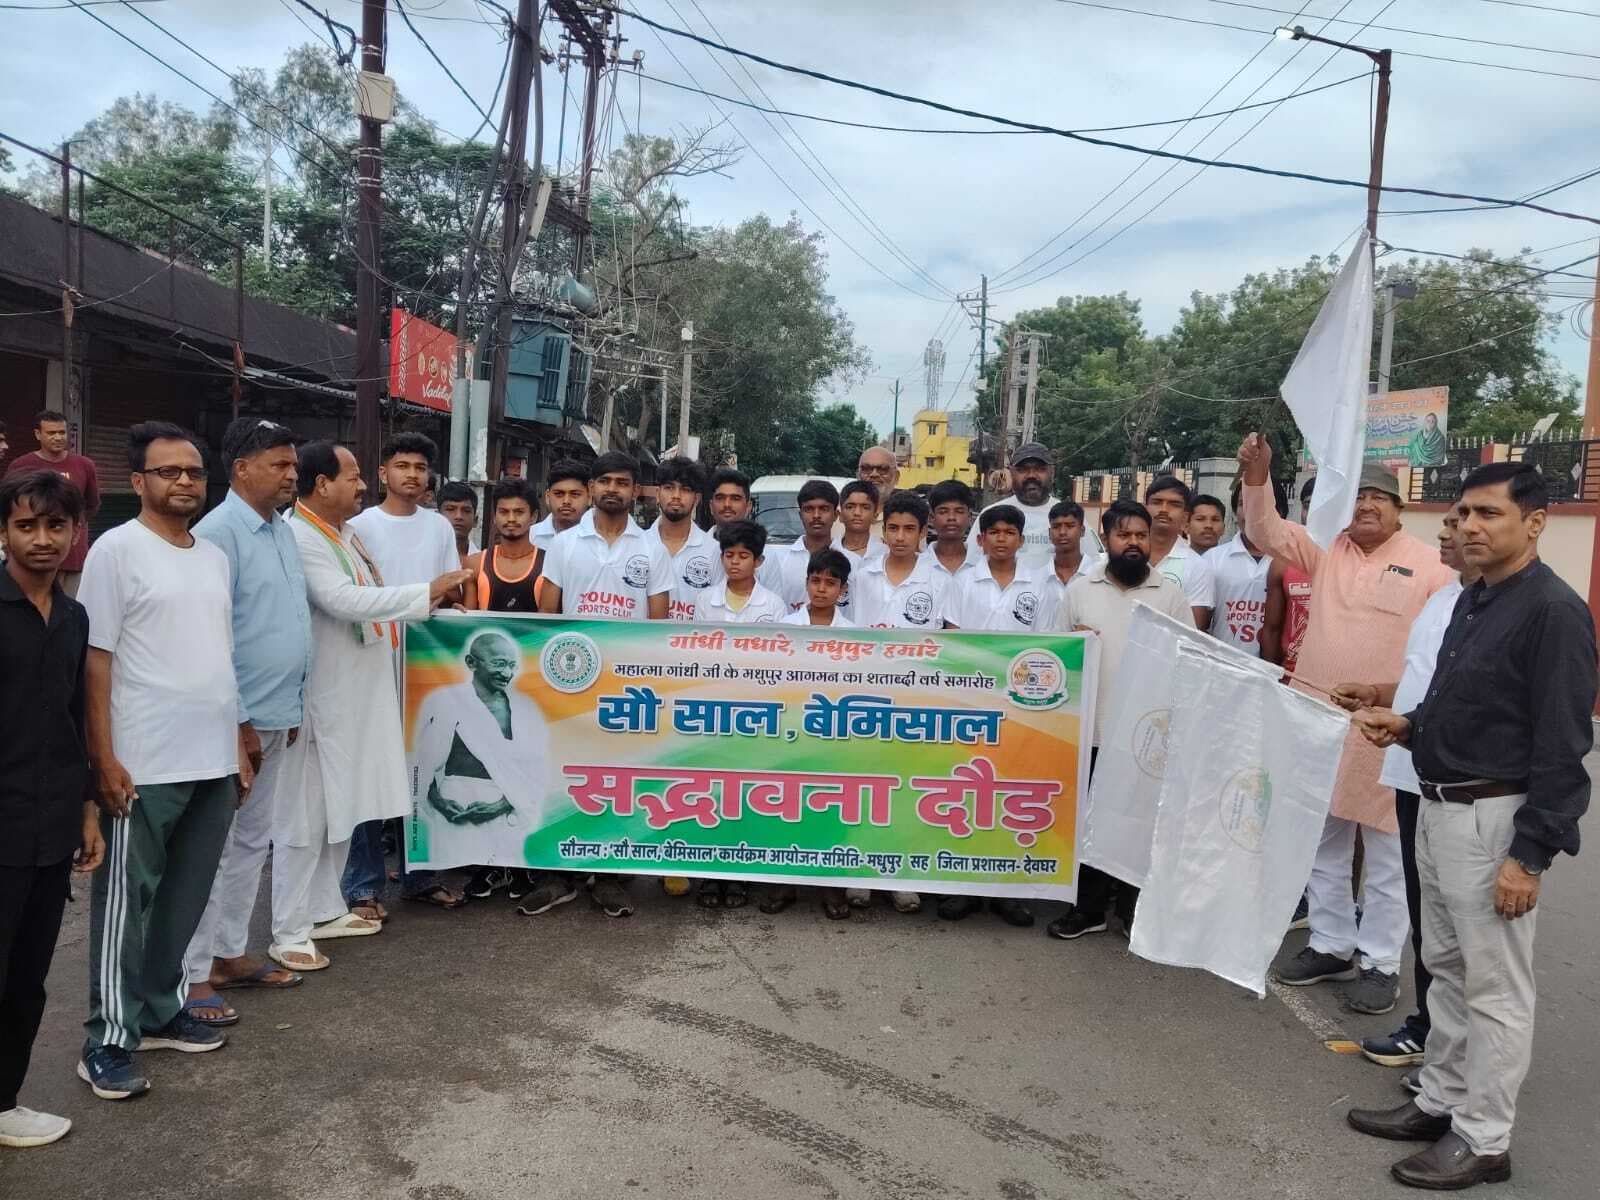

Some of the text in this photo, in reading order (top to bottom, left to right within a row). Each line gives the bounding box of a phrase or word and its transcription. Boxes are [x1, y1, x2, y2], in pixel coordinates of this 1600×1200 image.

[577, 591, 636, 610] YOUNG
[577, 604, 610, 616] SPORTS
[1226, 600, 1266, 613] YOU
[669, 631, 943, 661] गांधी पधारे, मधुपुर हमारे
[614, 662, 995, 690] महात्मा गांधी जी के मधुपुर आगमन का शताब्दी वर्ष समारोह
[597, 685, 664, 733] सौ
[802, 692, 1005, 745] बेमिसाल
[561, 756, 1063, 848] सद्भावना दौड़
[630, 844, 662, 862] साल,
[718, 843, 767, 864] कार्यक्रम
[769, 845, 819, 866] आयोजन
[867, 853, 902, 875] मधुपुर
[909, 853, 929, 871] सह
[937, 851, 969, 872] जिला
[1023, 854, 1057, 876] देवघर
